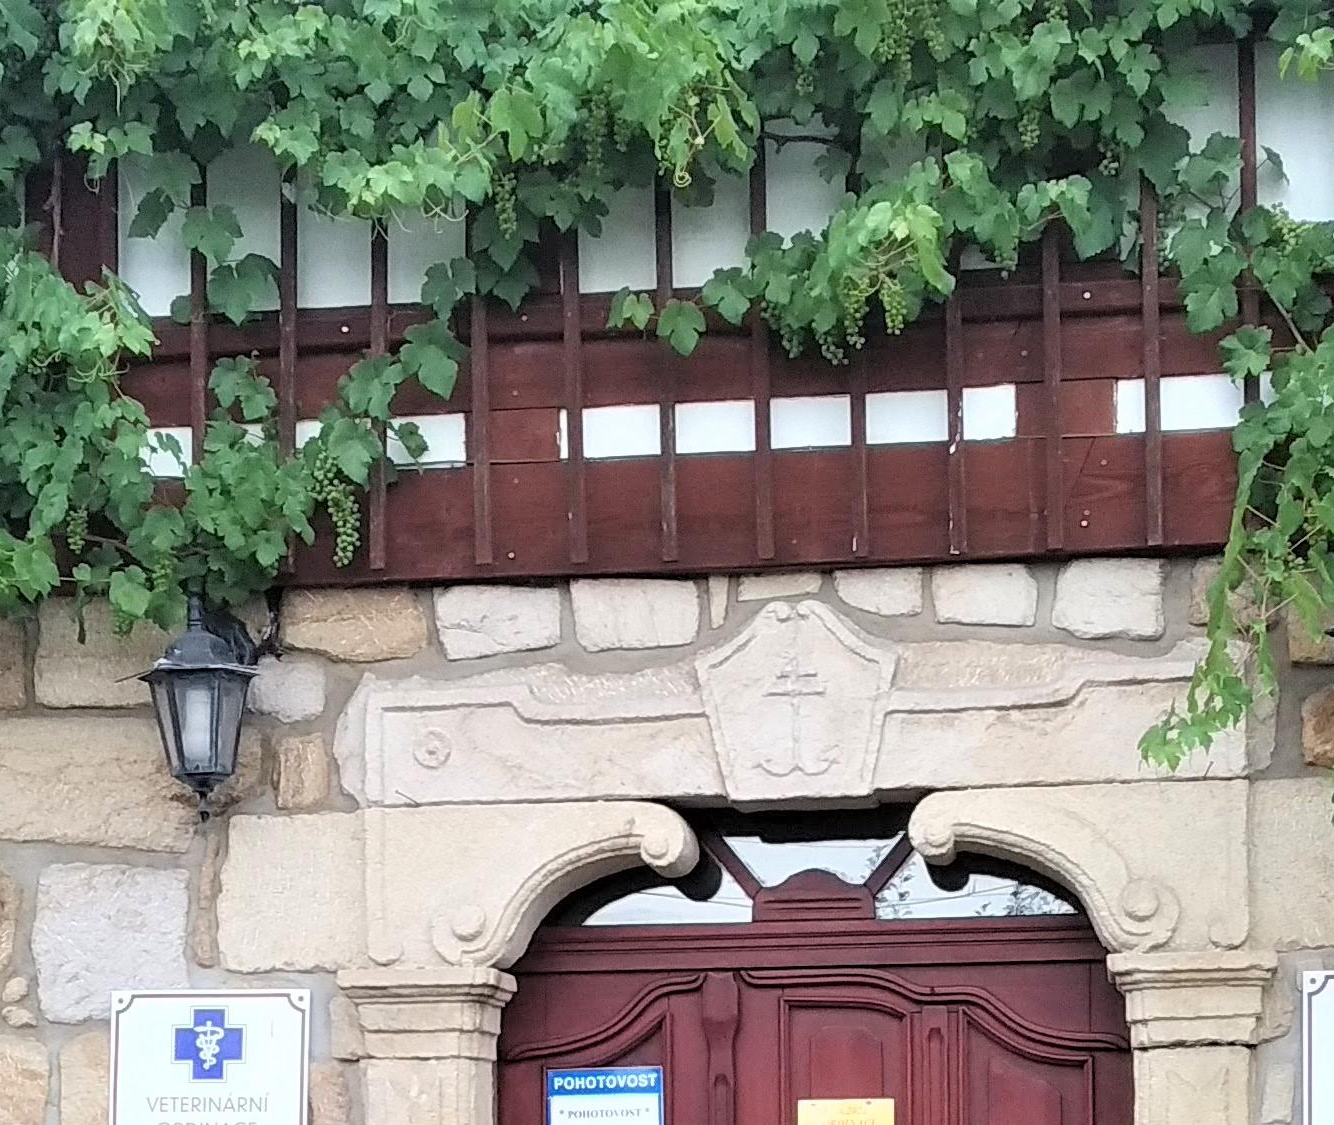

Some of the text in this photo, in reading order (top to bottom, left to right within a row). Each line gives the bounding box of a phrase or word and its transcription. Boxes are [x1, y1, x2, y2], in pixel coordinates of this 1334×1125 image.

[553, 1073, 658, 1090] POHOTOVOST
[146, 1091, 270, 1113] VETERINÁRNÍ
[568, 1108, 642, 1119] POHOTOVOST
